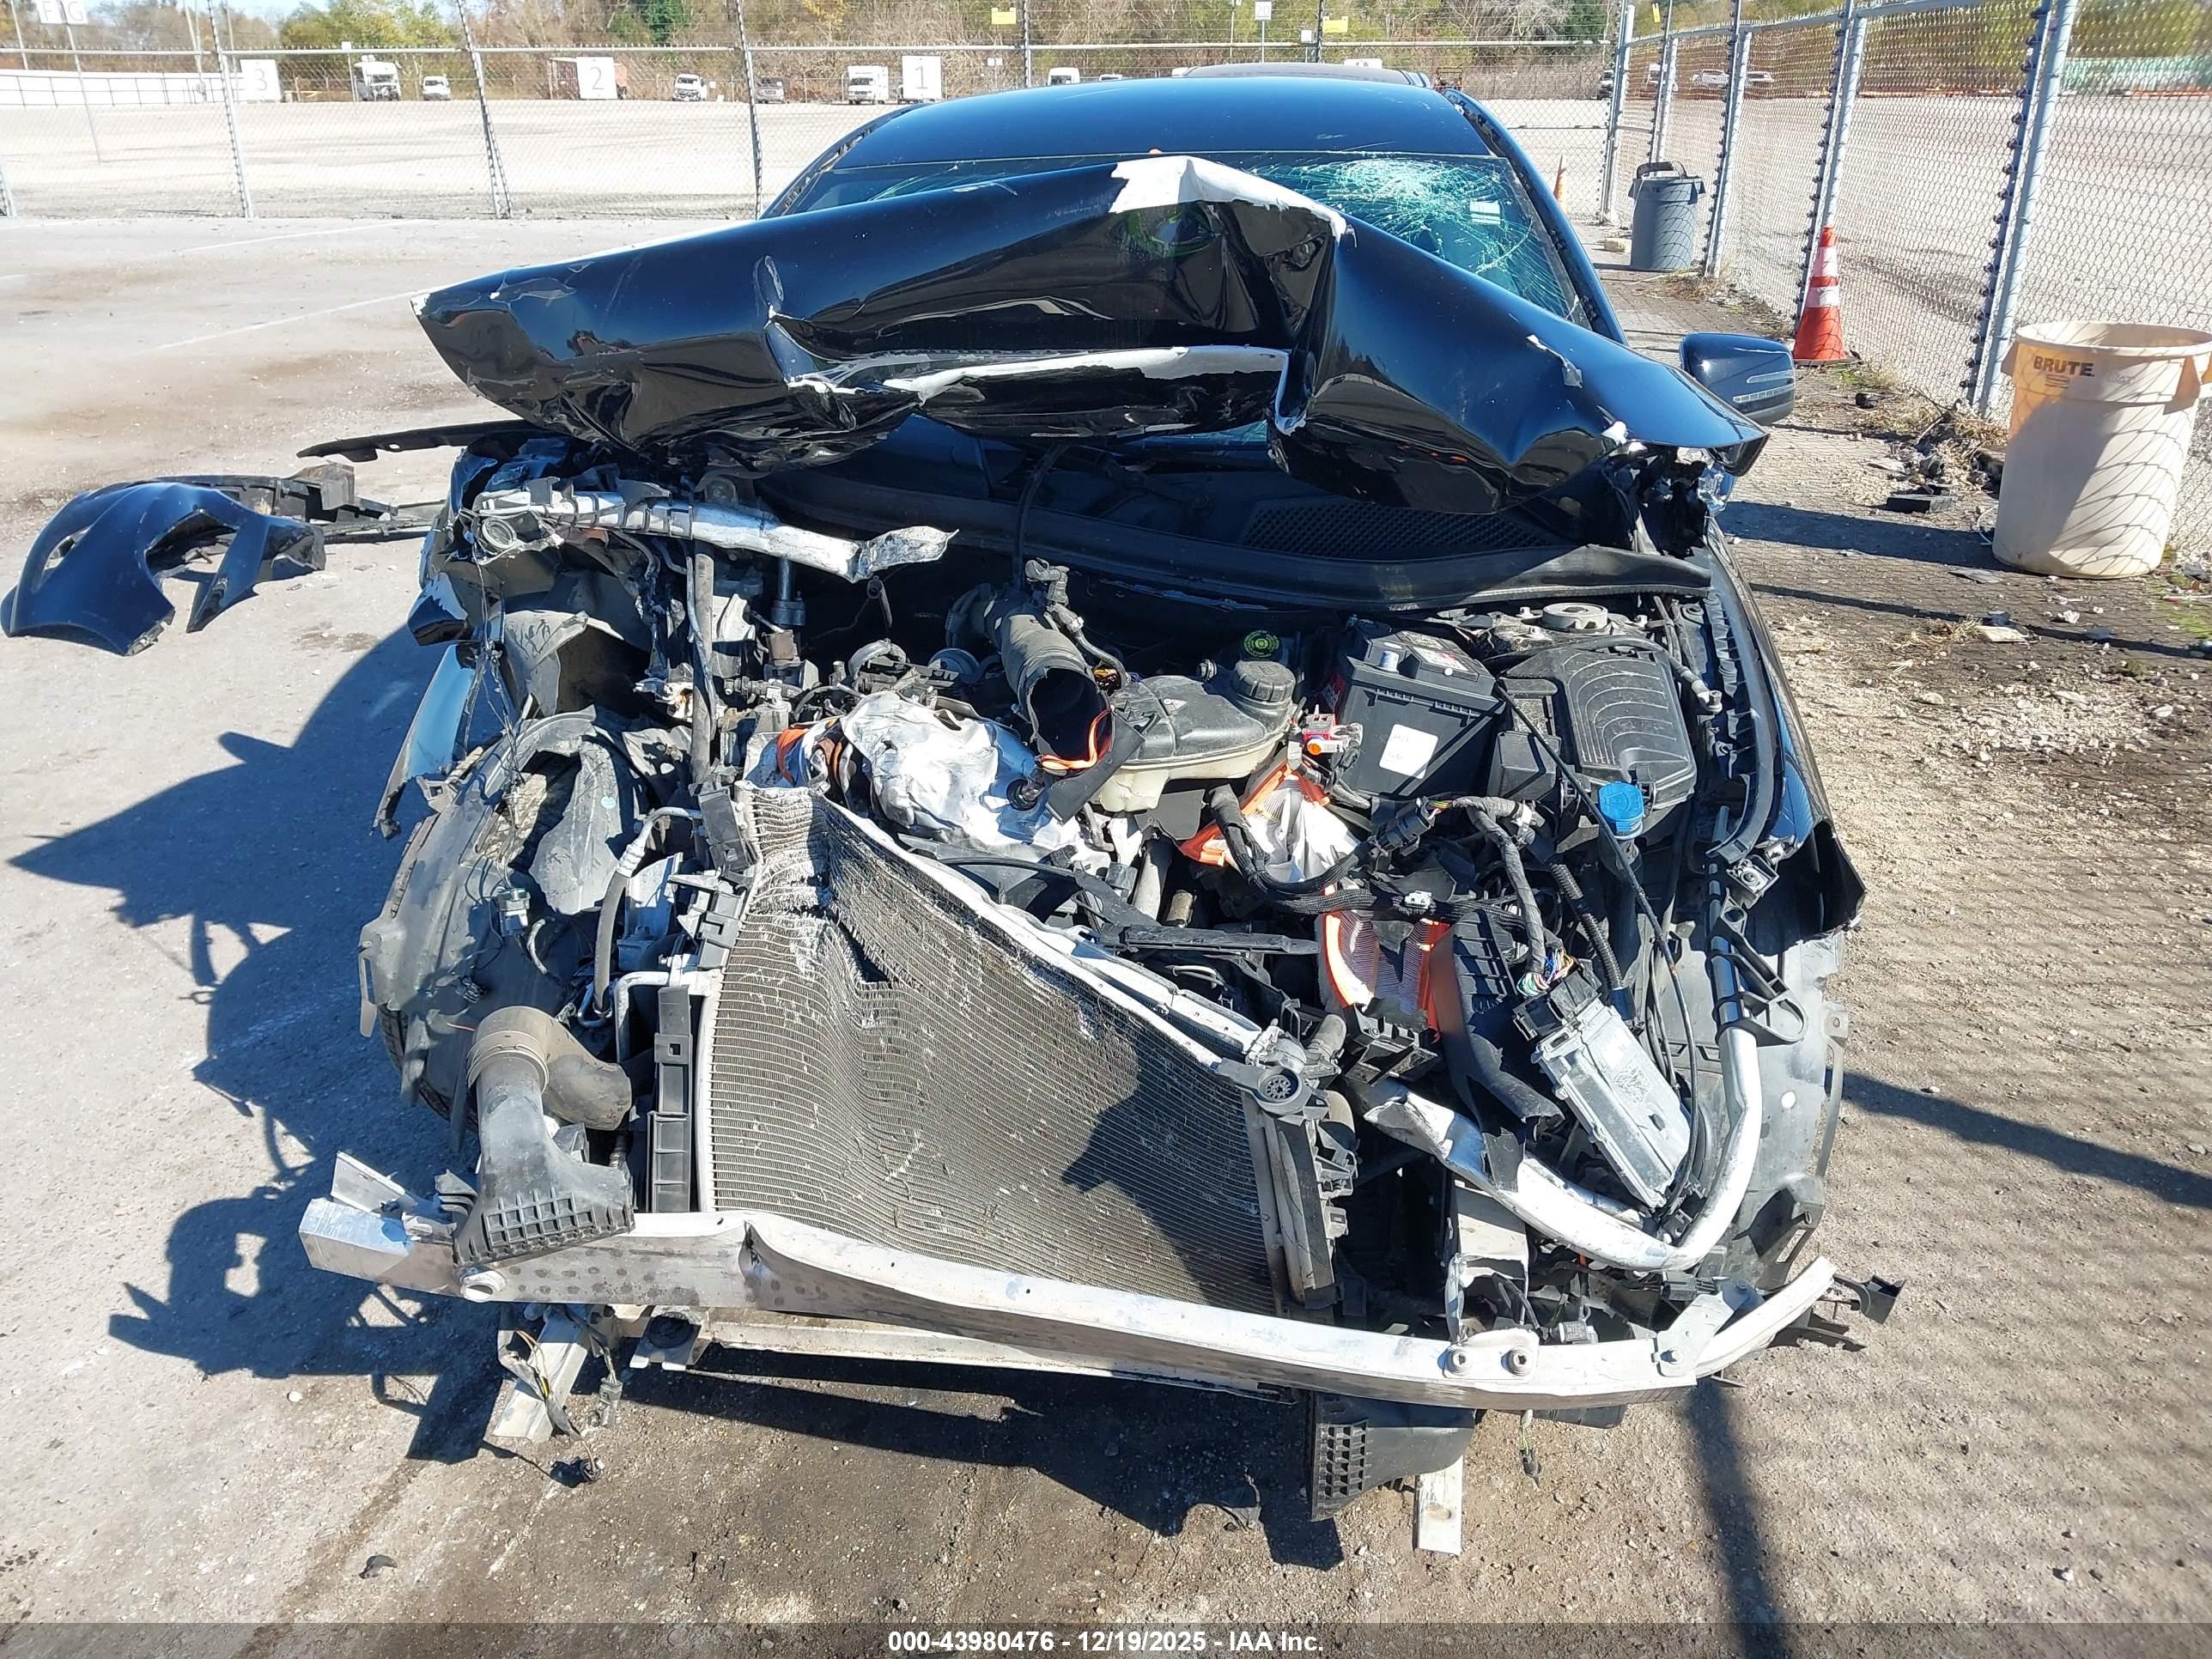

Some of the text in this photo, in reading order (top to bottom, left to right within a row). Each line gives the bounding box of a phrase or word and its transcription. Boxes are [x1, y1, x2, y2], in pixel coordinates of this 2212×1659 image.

[42, 1, 52, 21] F
[68, 1, 83, 21] G
[1256, 5, 1270, 16] 20
[254, 68, 267, 91] 3
[591, 66, 605, 90] 2
[915, 65, 928, 89] 1
